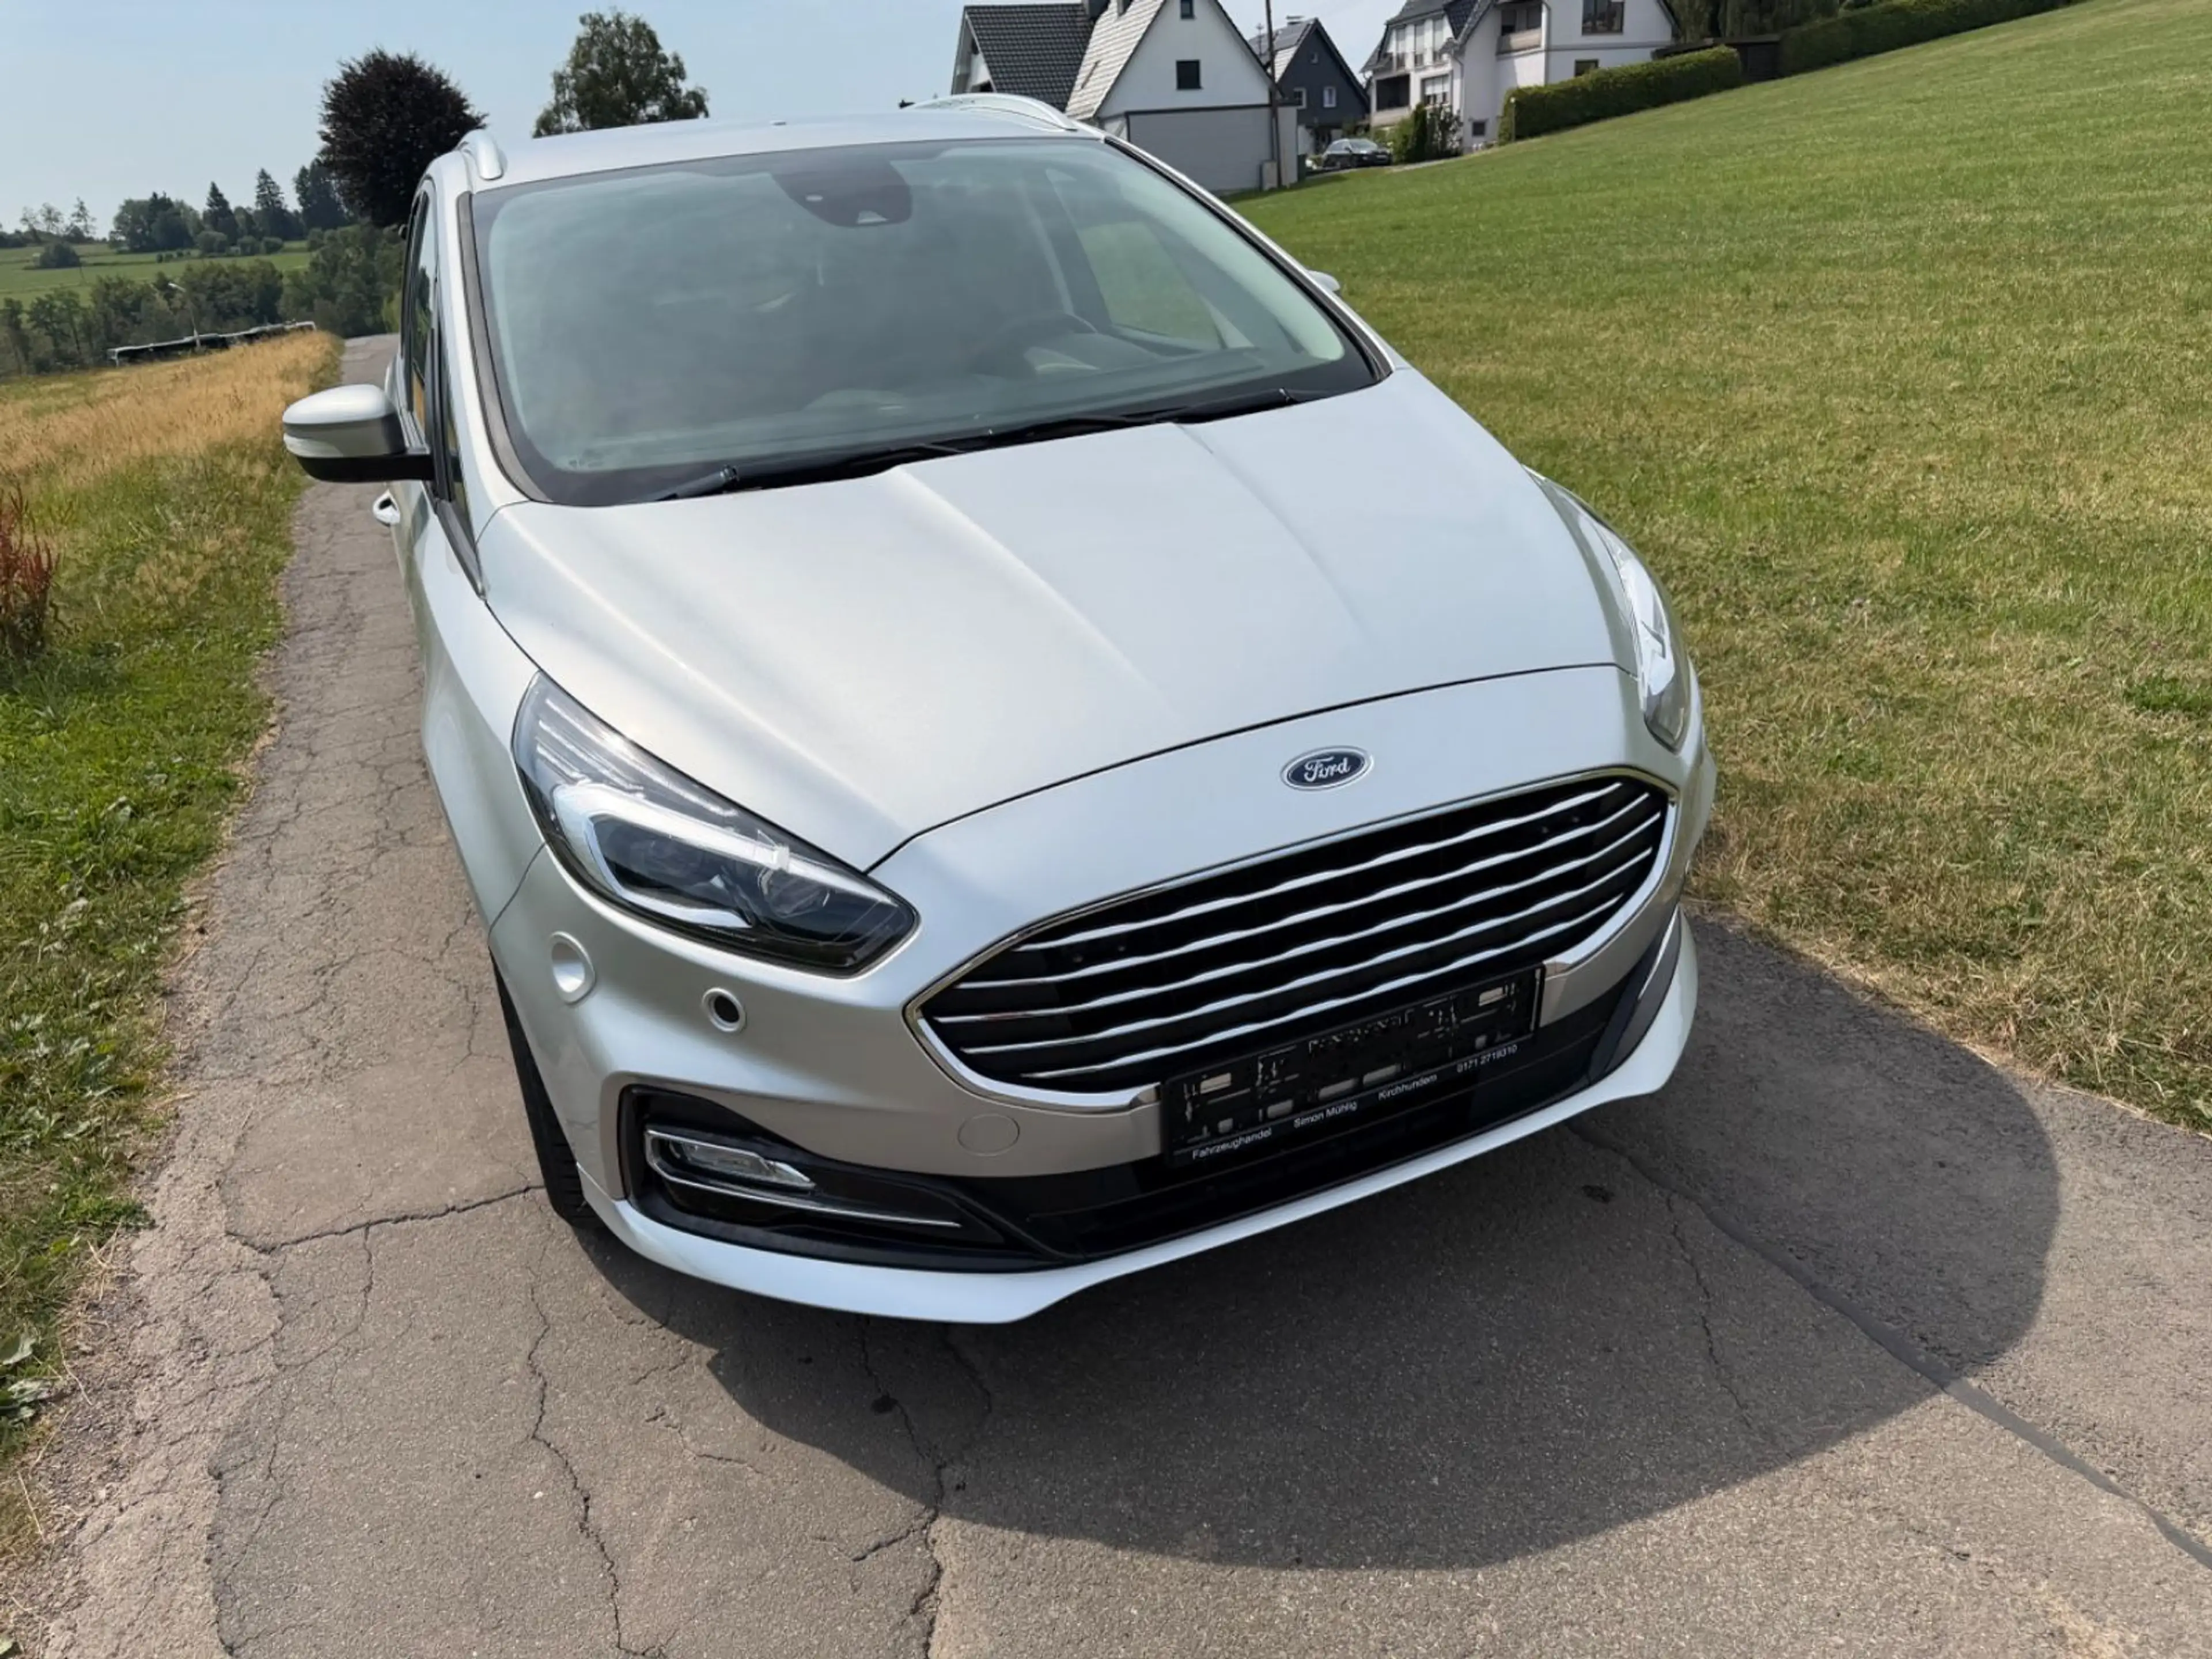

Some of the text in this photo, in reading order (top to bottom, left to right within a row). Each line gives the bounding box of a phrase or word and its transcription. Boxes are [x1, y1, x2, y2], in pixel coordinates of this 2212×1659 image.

[1304, 756, 1351, 782] Ford
[1192, 1127, 1272, 1160] Fahrzeughandel
[1293, 1111, 1325, 1129] Simon
[1456, 1058, 1478, 1074] 0171
